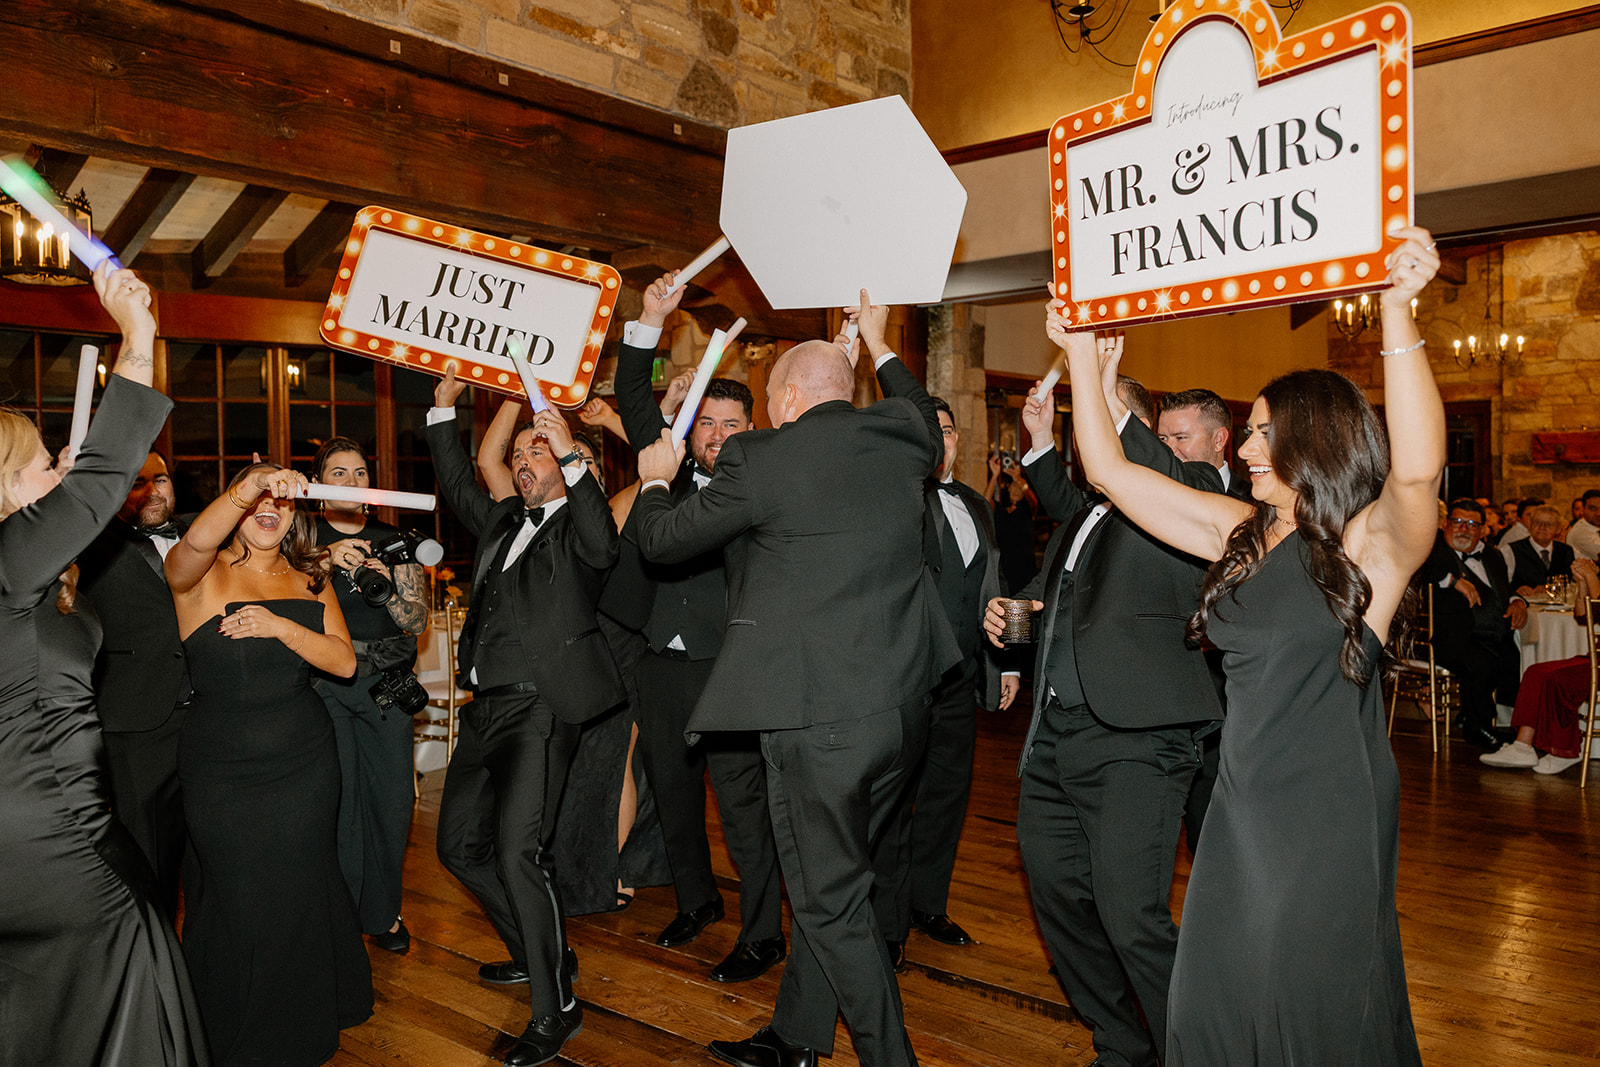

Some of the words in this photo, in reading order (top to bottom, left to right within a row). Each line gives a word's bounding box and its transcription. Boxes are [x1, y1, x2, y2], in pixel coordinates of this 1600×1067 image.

[1166, 92, 1243, 128] Introducing
[1079, 164, 1157, 220] MR.
[1171, 142, 1211, 195] &
[1225, 104, 1359, 185] MRS.
[1110, 188, 1319, 276] FRANCIS
[426, 261, 525, 311] JUST
